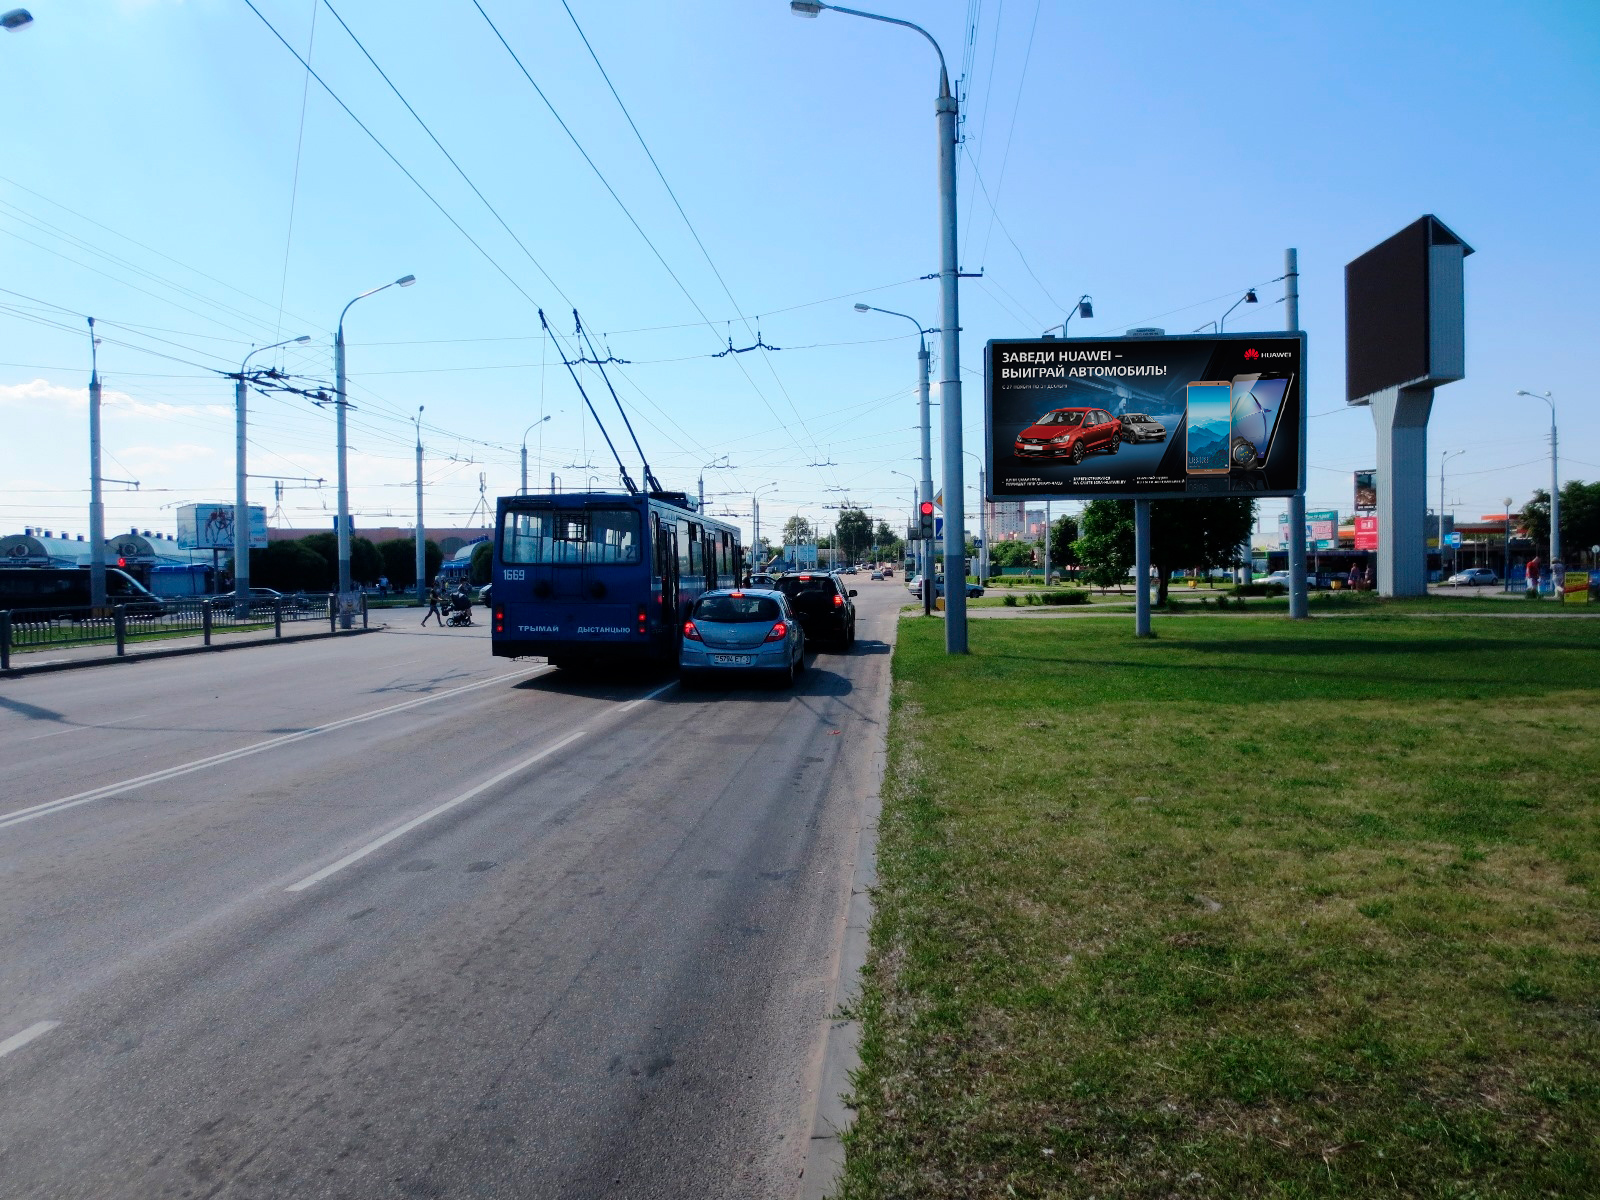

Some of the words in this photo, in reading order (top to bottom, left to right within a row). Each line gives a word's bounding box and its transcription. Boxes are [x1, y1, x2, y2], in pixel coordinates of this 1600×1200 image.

[1002, 351, 1055, 365] ЗАВЕДИ
[1058, 350, 1112, 362] HUAWEI
[1001, 365, 1065, 379] ВЫИГРАЙ
[1068, 365, 1167, 378] АВТОМОБИЛЬ!
[503, 569, 525, 581] 1669
[577, 626, 631, 634] ДЫСТАНЦЫЮ
